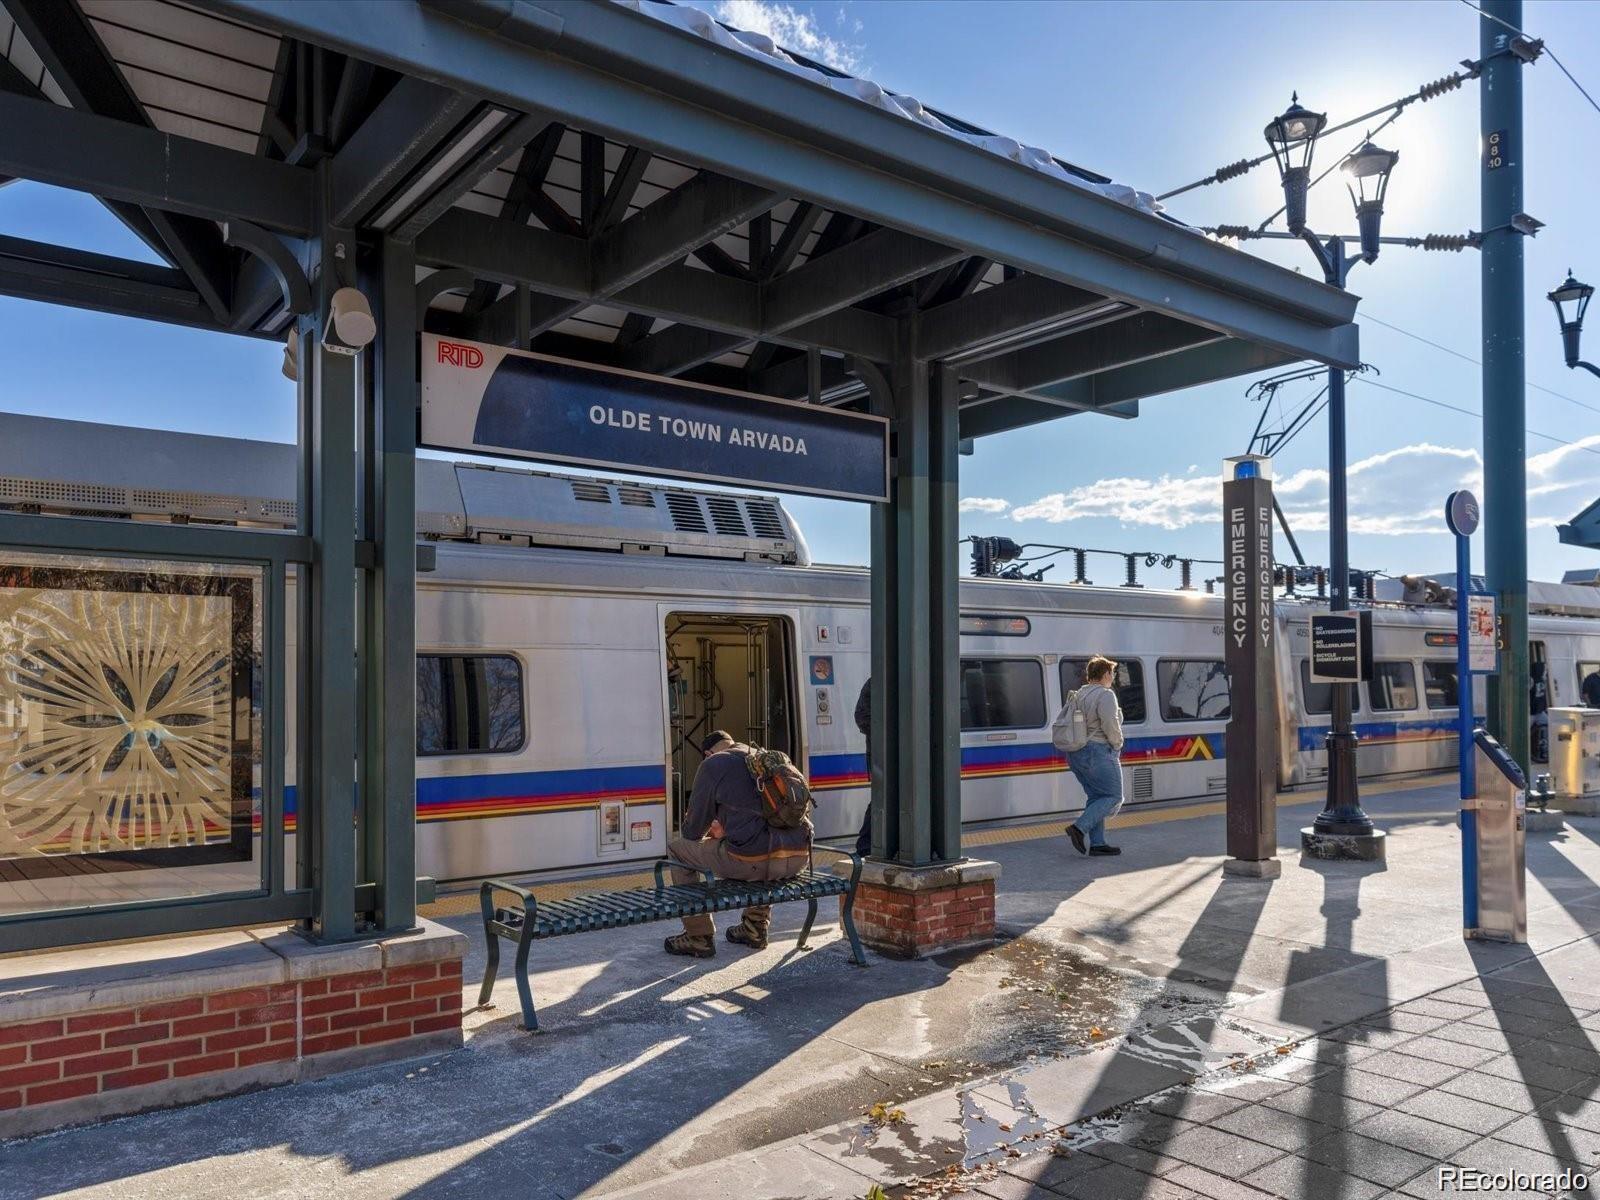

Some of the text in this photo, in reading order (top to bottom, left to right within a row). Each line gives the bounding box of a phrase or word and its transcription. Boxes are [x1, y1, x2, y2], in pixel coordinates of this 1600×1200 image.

[438, 340, 484, 369] RTD
[589, 405, 808, 455] OLDE TOWN ARVADA
[1231, 507, 1247, 648] EMERGENCY
[1259, 507, 1270, 648] EMERGENCY
